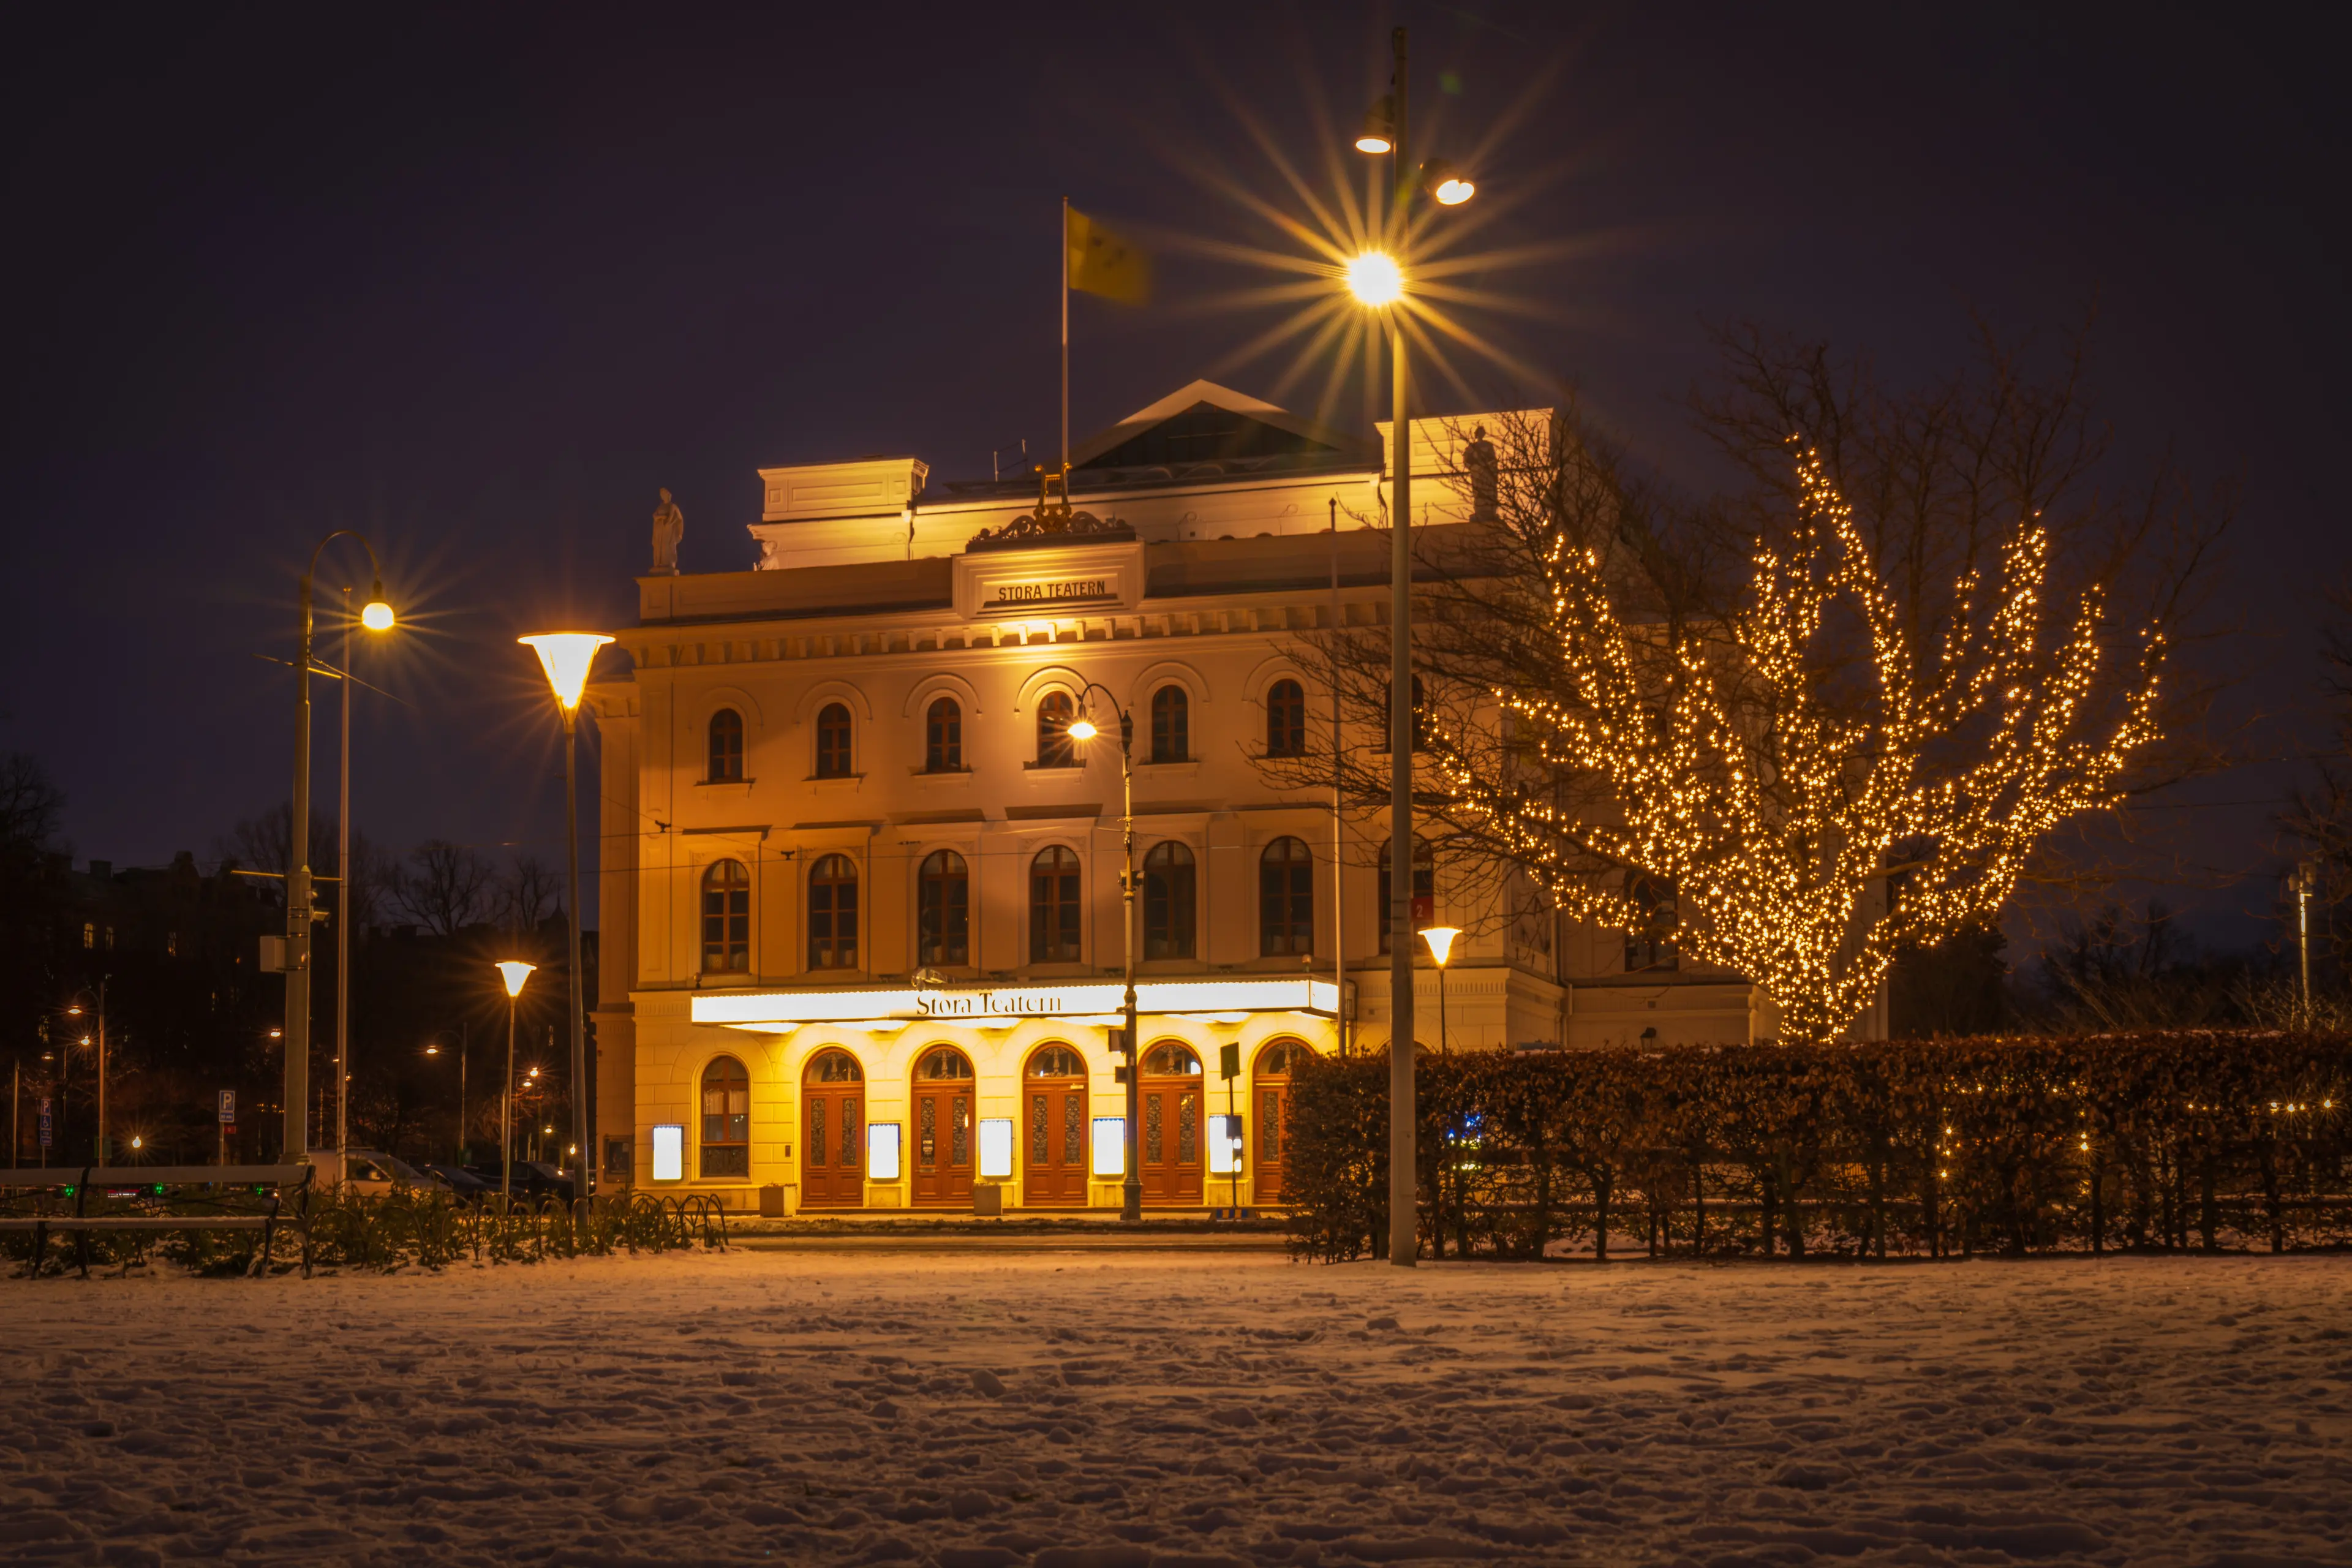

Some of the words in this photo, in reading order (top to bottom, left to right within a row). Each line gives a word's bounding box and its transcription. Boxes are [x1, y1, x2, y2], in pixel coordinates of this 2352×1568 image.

[999, 585, 1042, 601] STORA
[1047, 580, 1105, 597] TEATERN
[1416, 903, 1423, 918] 2
[917, 995, 971, 1016] Stora
[979, 992, 1061, 1013] Teatern
[43, 1100, 49, 1113] P
[223, 1093, 232, 1109] P
